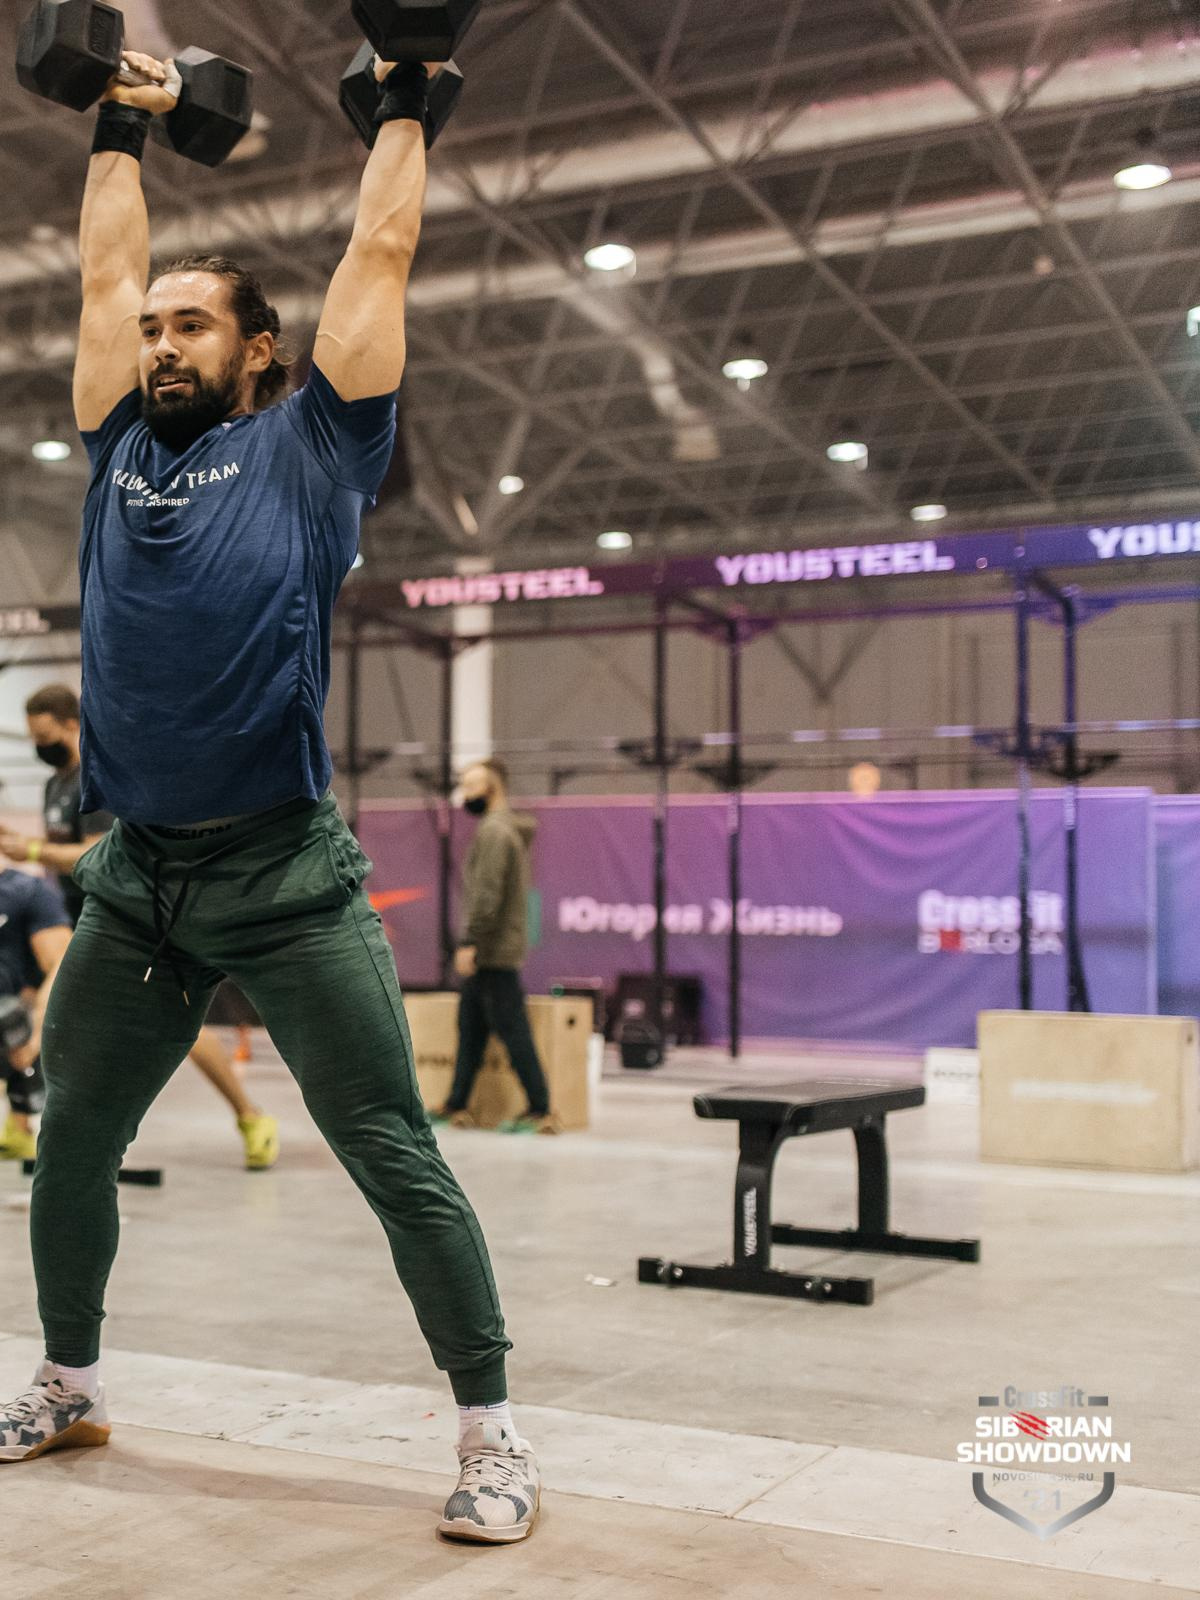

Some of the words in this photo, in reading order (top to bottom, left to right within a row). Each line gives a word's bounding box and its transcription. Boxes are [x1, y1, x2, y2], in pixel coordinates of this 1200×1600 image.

[186, 462, 240, 489] TEAM
[715, 540, 955, 586] YOUSTEEL
[401, 566, 605, 608] YOUSTEEL
